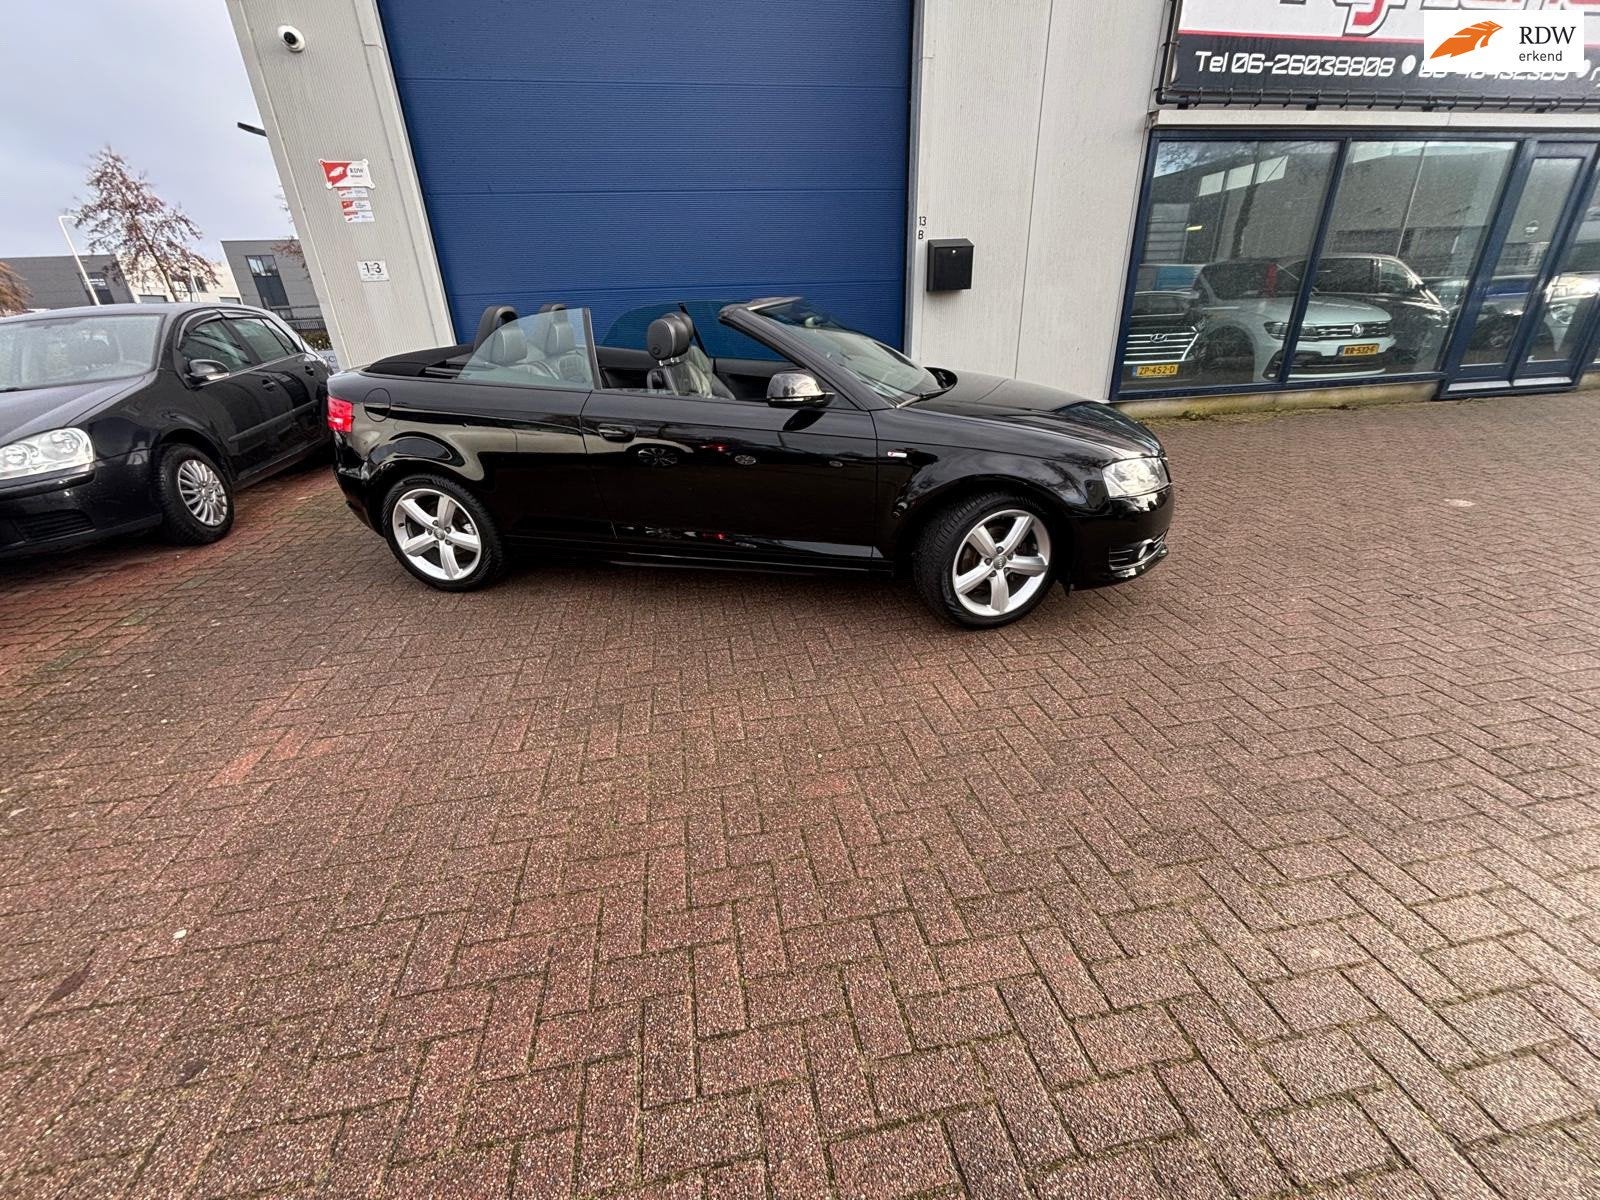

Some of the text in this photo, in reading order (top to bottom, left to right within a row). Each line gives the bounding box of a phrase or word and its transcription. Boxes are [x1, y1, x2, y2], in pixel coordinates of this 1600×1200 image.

[1195, 50, 1228, 73] Tel
[1231, 52, 1396, 77] 06-26038808
[918, 215, 927, 227] 13
[1139, 365, 1176, 375] ZP-452-D
